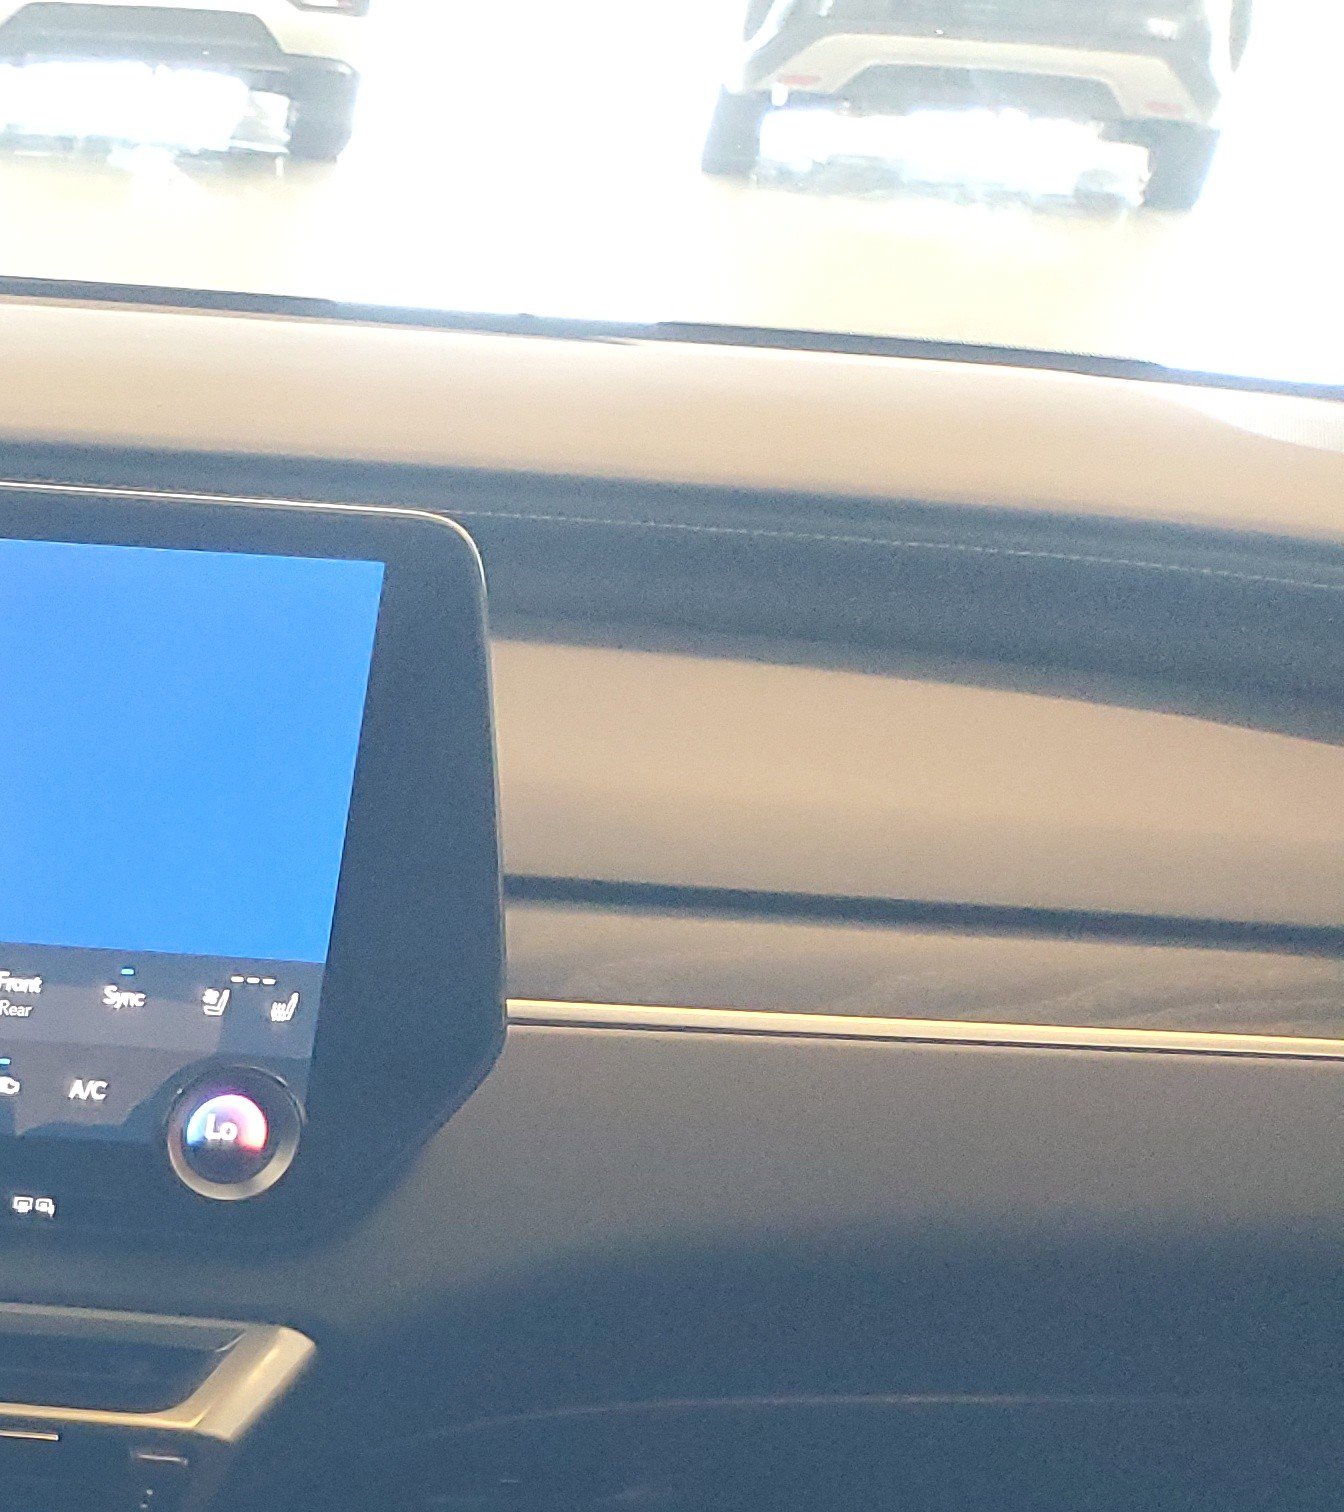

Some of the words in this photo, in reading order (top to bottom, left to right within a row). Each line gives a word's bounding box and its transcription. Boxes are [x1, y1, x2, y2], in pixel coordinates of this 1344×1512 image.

[103, 985, 147, 1010] Sync
[68, 1079, 109, 1101] A/C
[204, 1113, 238, 1141] Lo
